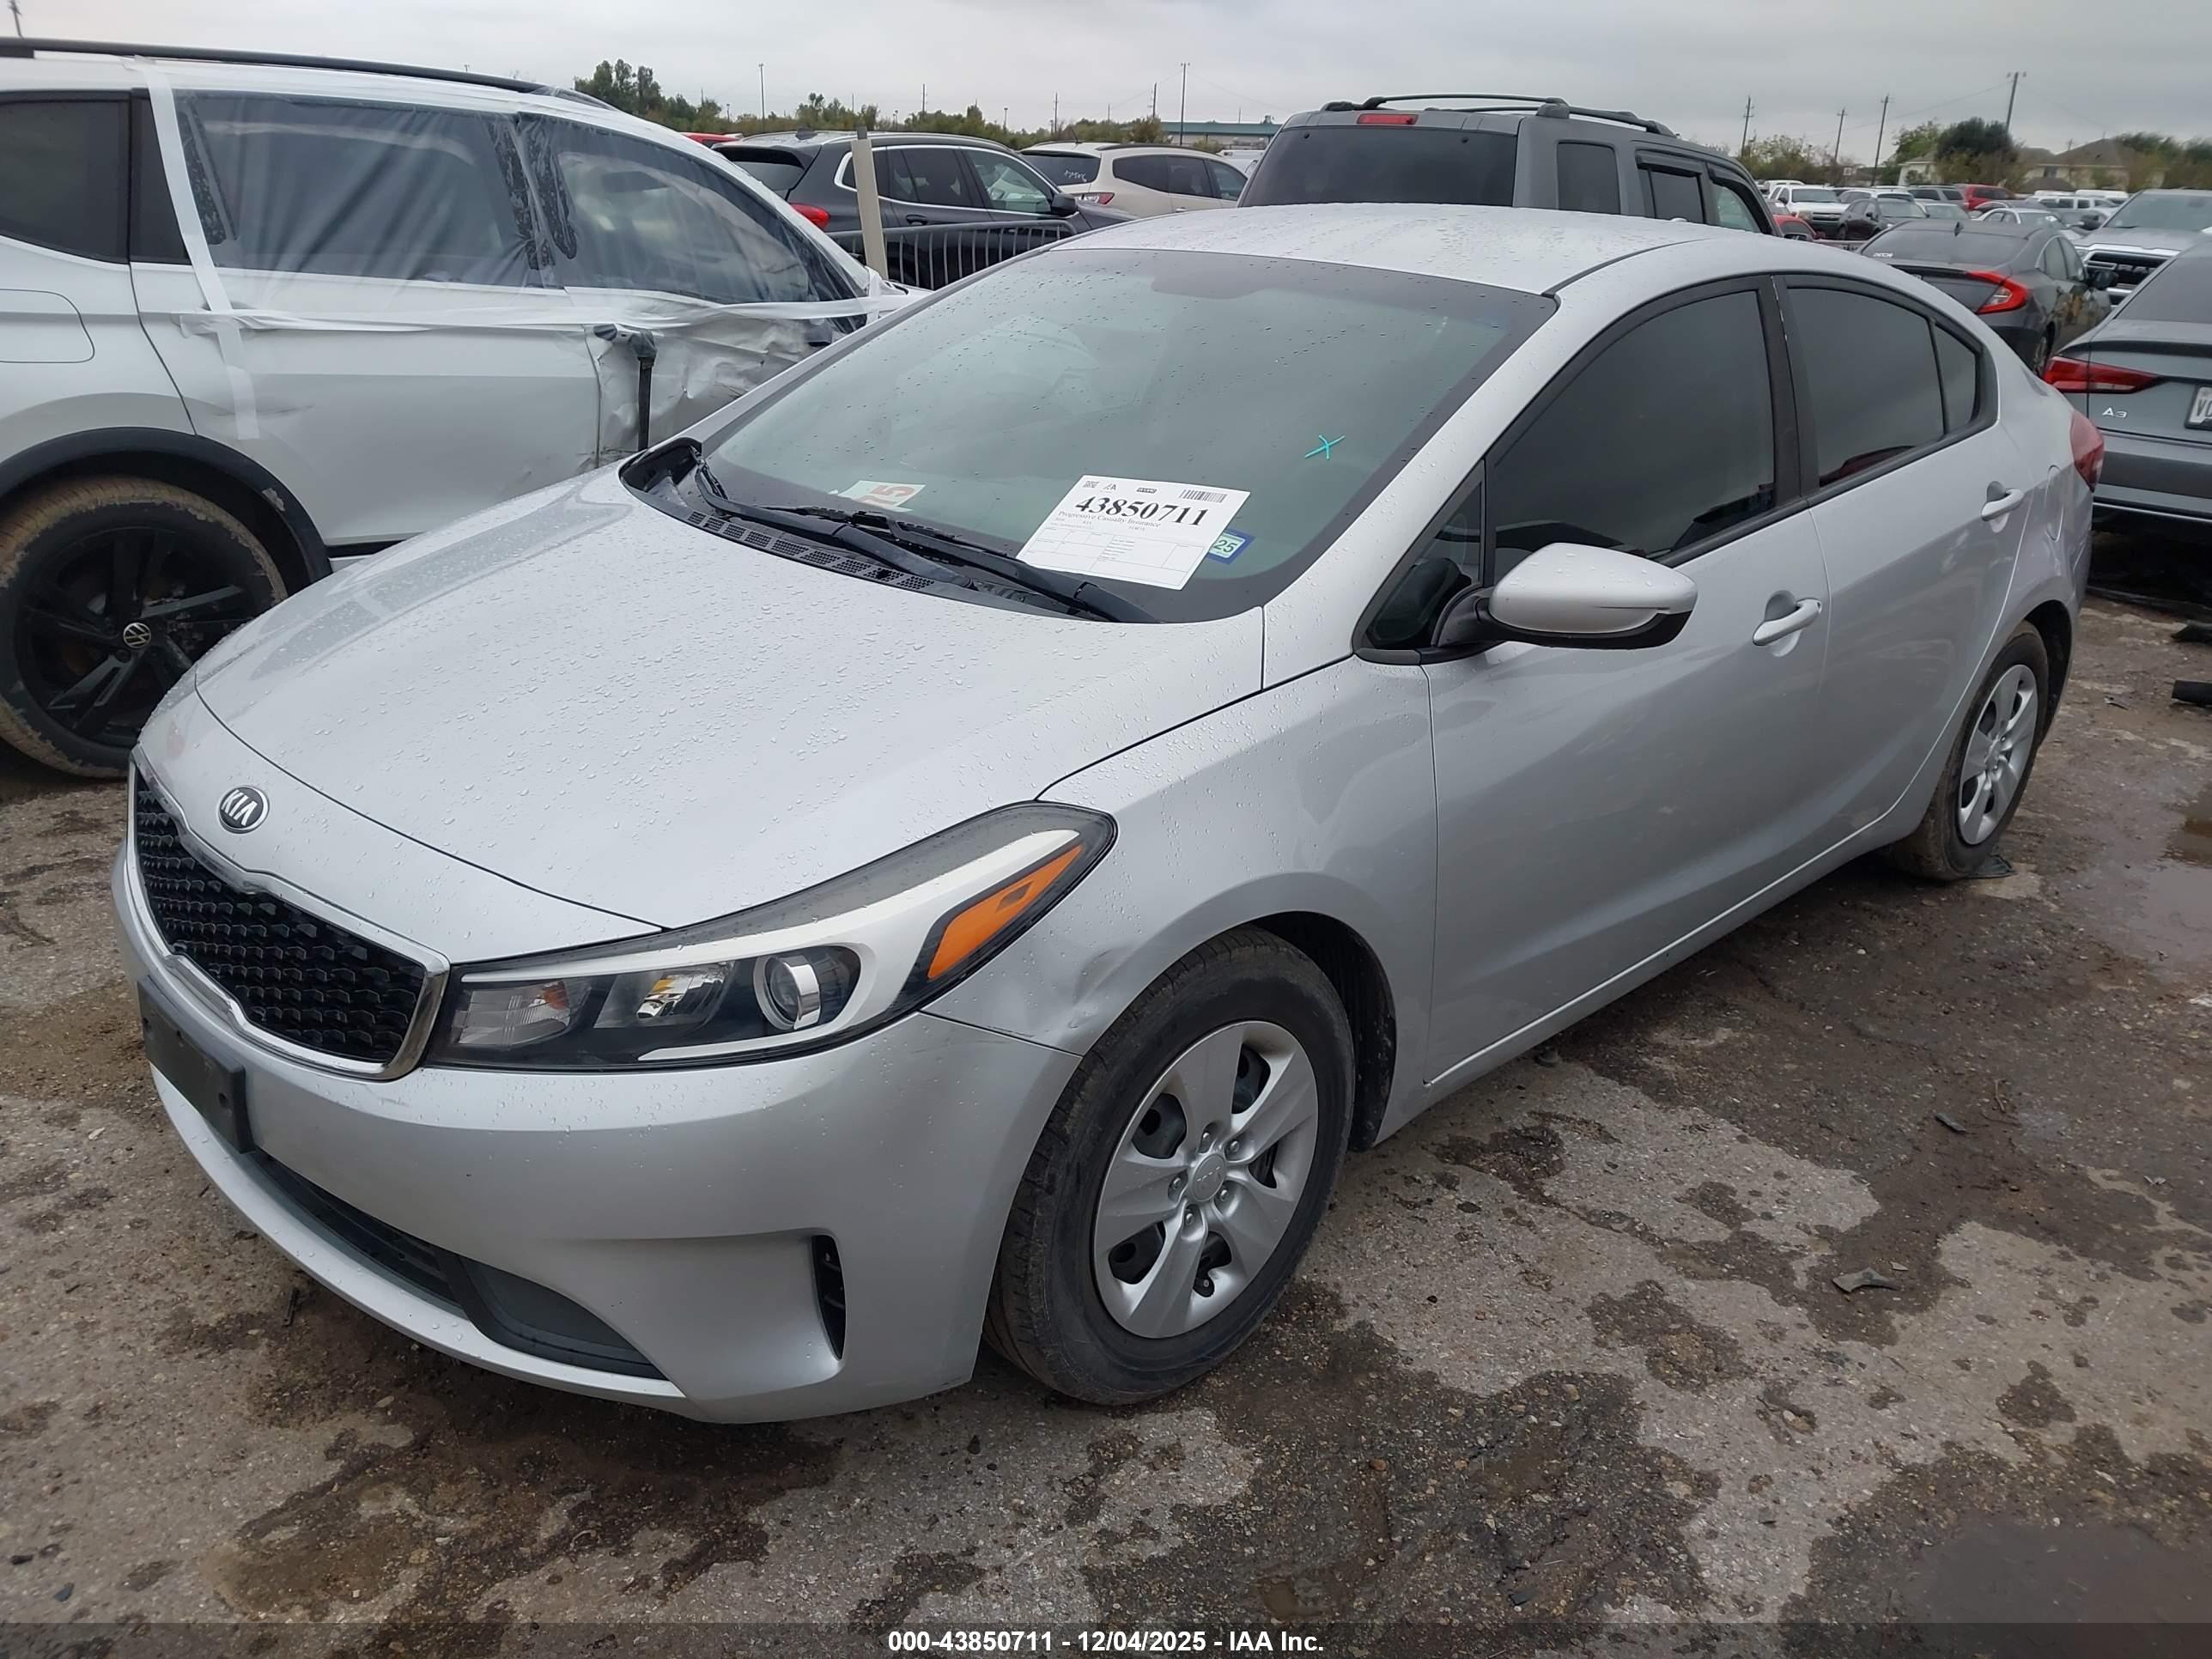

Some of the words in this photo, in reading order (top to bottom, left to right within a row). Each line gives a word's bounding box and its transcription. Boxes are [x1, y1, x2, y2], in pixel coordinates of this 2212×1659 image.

[2102, 407, 2127, 418] A3
[1075, 495, 1209, 526] 43850711
[1213, 539, 1238, 553] 25
